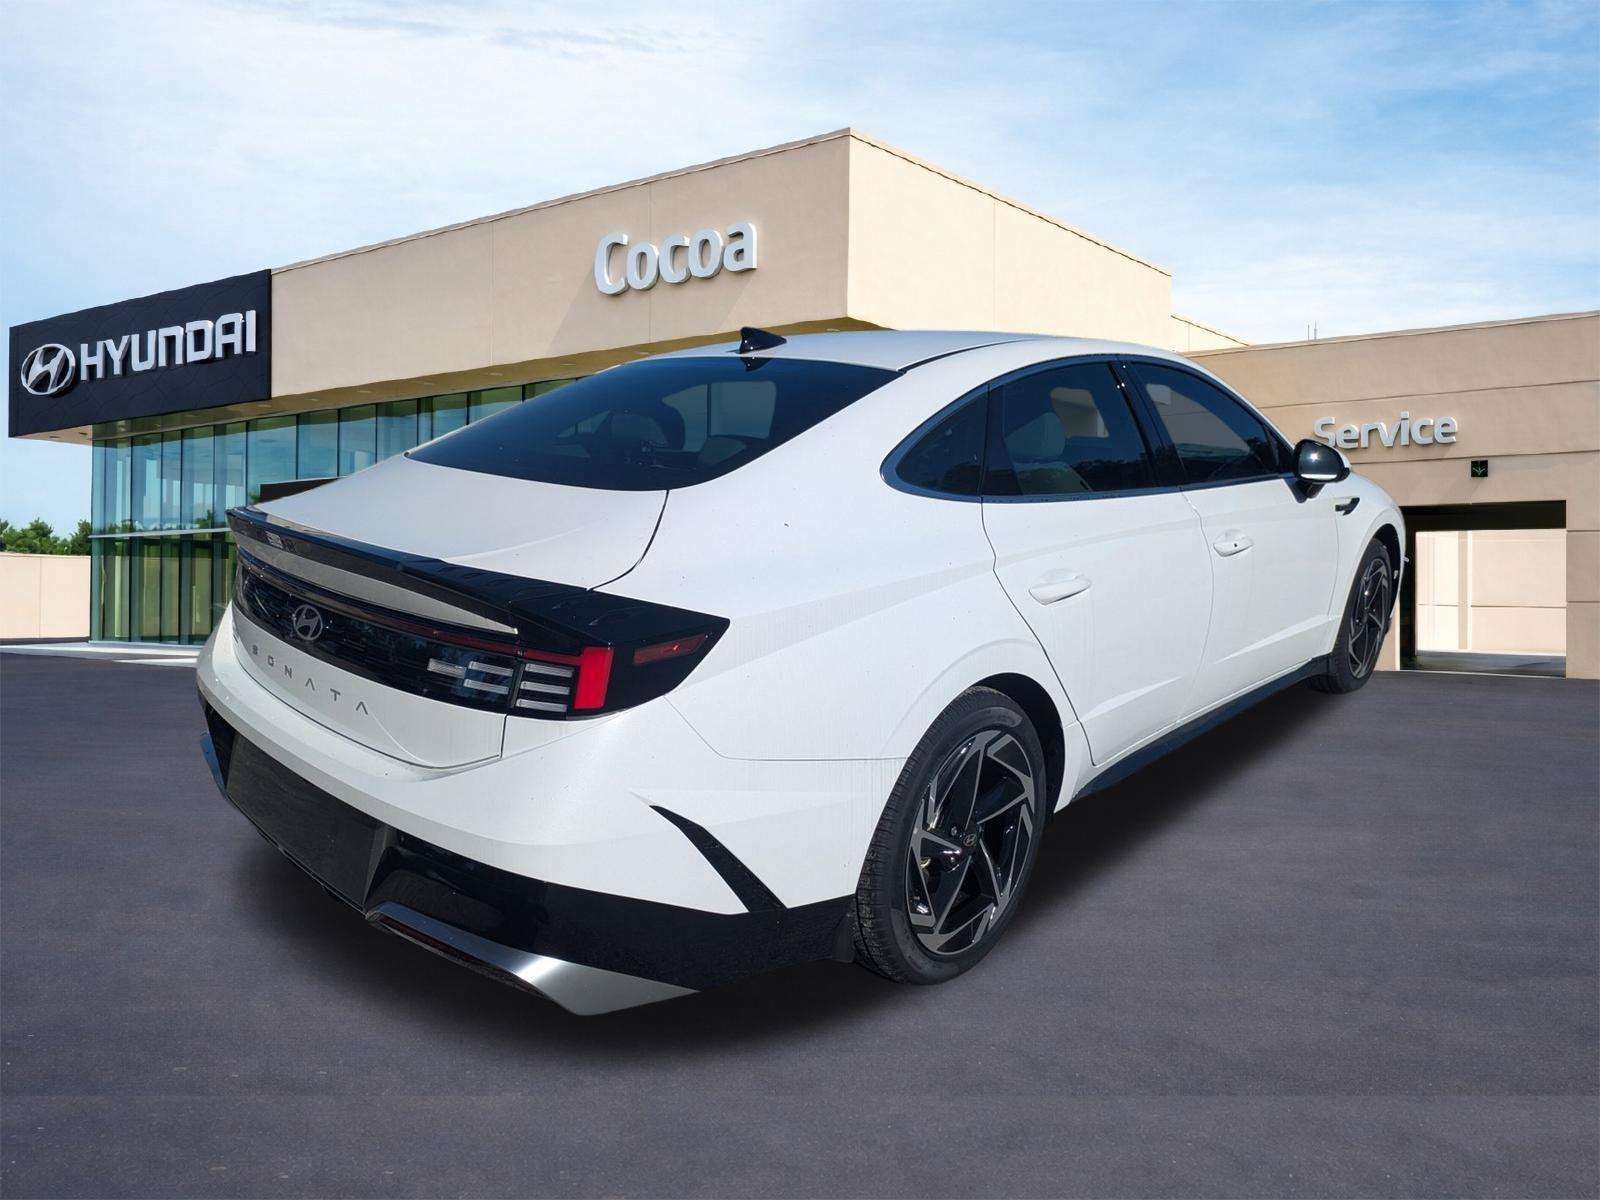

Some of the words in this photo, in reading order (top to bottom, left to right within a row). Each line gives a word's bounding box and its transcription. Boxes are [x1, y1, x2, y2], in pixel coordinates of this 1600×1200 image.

[594, 222, 758, 296] Cocoa
[80, 309, 257, 381] HYUNDAI
[1313, 411, 1458, 449] Service
[252, 645, 369, 715] SONATA
